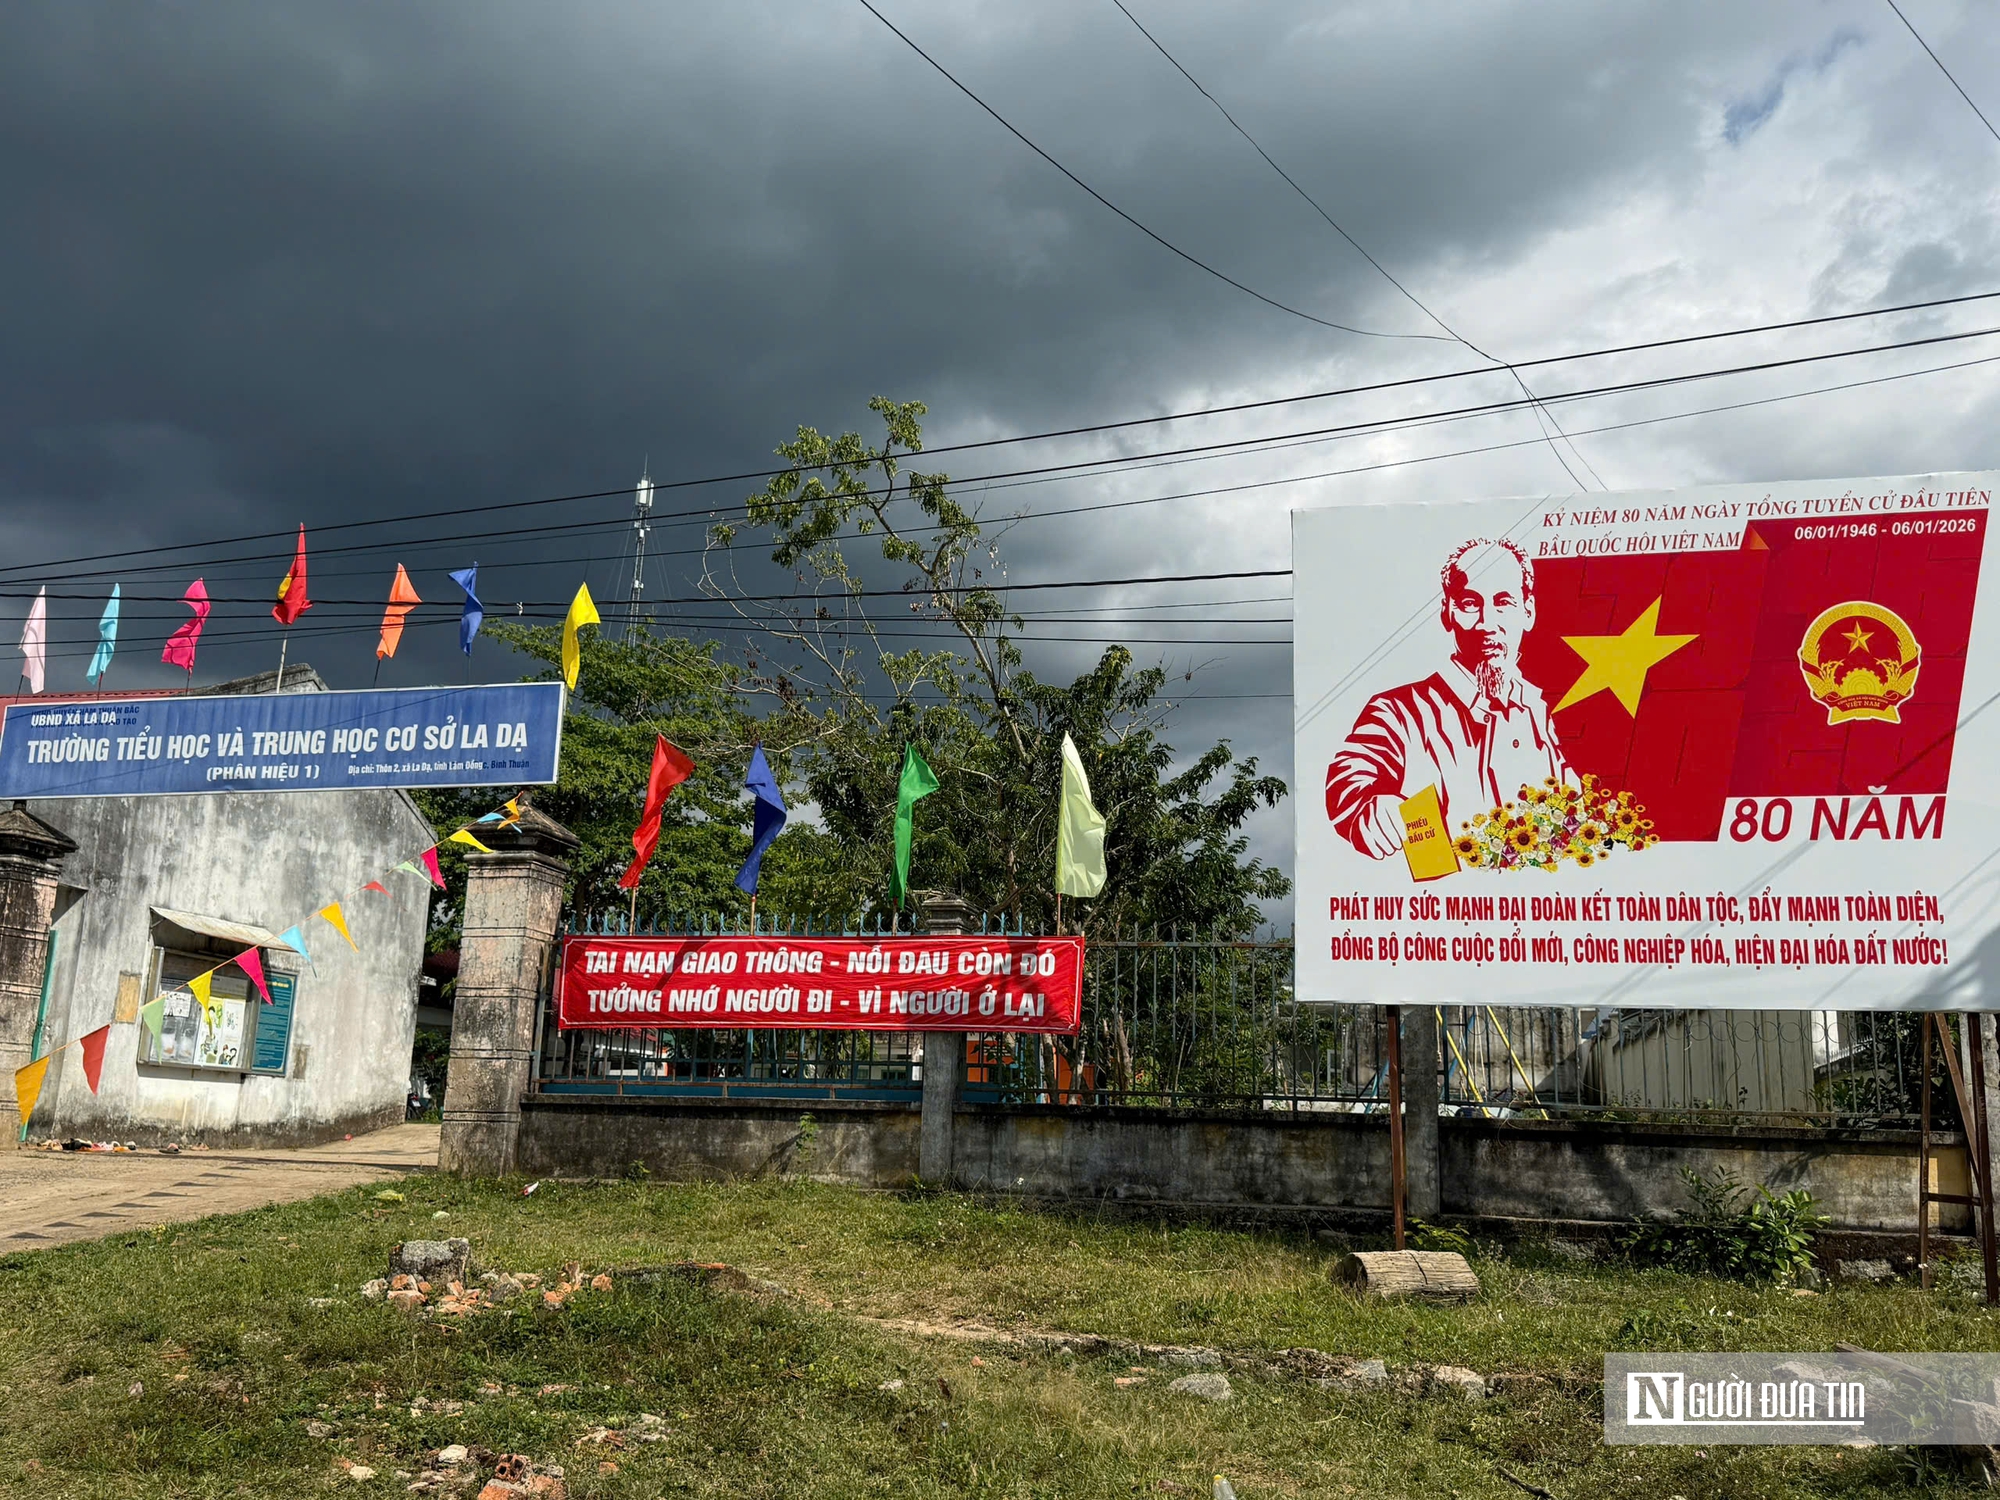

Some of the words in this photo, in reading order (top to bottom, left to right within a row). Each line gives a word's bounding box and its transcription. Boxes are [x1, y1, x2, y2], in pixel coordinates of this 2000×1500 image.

[1543, 507, 1566, 527] KỶ
[1570, 506, 1617, 528] NIỆM
[1621, 509, 1640, 523] 80
[1644, 504, 1692, 522] NĂM
[1691, 500, 1741, 519] NGÀY
[1746, 494, 1797, 516] TỔNG
[1802, 490, 1864, 513] TUYỂN
[1868, 489, 1897, 510] CỬ
[1900, 487, 1940, 509] ĐẦU
[1946, 487, 1992, 506] TIÊN
[1538, 533, 1571, 556] BẦU
[1575, 531, 1622, 557] QUỐC
[1702, 532, 1741, 548] NAM
[1794, 523, 1877, 540] 06/01/1946
[1891, 519, 1976, 536] 06/01/2026
[31, 714, 63, 727] UBND
[84, 713, 97, 724] LA
[101, 711, 117, 726] DẠ
[27, 733, 110, 763] TRƯỜNG
[116, 725, 162, 760] TIỂU
[166, 733, 211, 764] HỌC
[217, 727, 244, 756] VÀ
[252, 730, 326, 756] TRUNG
[332, 728, 378, 758] HỌC
[385, 724, 418, 752] CƠ
[424, 715, 457, 750] SỞ
[460, 724, 488, 749] LA
[495, 723, 528, 752] DẠ
[206, 763, 256, 782] (PHÂN
[261, 763, 299, 782] HIỆU
[303, 764, 320, 780] 1)
[348, 764, 360, 775] Địa
[376, 763, 392, 773] Thôn
[412, 763, 421, 772] La
[1729, 798, 1793, 842] 80
[1809, 785, 1956, 840] NĂM
[1330, 891, 1369, 920] PHÁT
[1374, 897, 1404, 920] HUY
[1409, 890, 1440, 920] SỨC
[1446, 897, 1494, 926] MẠNH
[1499, 897, 1526, 926] ĐẠI
[1531, 891, 1577, 921] ĐOÀN
[1581, 888, 1611, 921] KẾT
[1616, 891, 1660, 921] TOÀN
[1666, 891, 1701, 921] DÂN
[1706, 891, 1744, 927] TỘC,
[1749, 886, 1782, 921] ĐẨY
[1787, 896, 1840, 927] MẠNH
[1844, 890, 1891, 921] TOÀN
[1897, 890, 1944, 927] DIỆN,
[585, 951, 618, 973] TAI
[623, 952, 675, 978] NẠN
[681, 952, 738, 974] GIAO
[745, 946, 823, 973] THÔNG
[847, 944, 891, 973] NỖI
[898, 951, 949, 974] ĐAU
[957, 946, 1012, 976] CÒN
[1020, 948, 1056, 976] ĐÓ
[1331, 928, 1373, 960] ĐỒNG
[1378, 932, 1399, 966] BỘ
[1404, 932, 1447, 961] CÔNG
[1451, 932, 1495, 967] CUỘC
[1499, 928, 1526, 962] ĐỔI
[1531, 931, 1568, 966] MỚI,
[1573, 933, 1619, 963] CÔNG
[1624, 933, 1685, 969] NGHIỆP
[1690, 933, 1731, 967] HÓA,
[1735, 934, 1774, 970] HIỆN
[1780, 938, 1809, 970] ĐẠI
[1814, 933, 1850, 964] HÓA
[1854, 930, 1887, 964] ĐẤT
[1893, 931, 1948, 965] NƯỚC!
[588, 982, 662, 1013] TƯỞNG
[668, 984, 720, 1013] NHỚ
[725, 983, 800, 1013] NGƯỜI
[806, 989, 832, 1013] ĐI
[858, 985, 882, 1013] VÌ
[889, 986, 970, 1015] NGƯỜI
[978, 984, 997, 1015] Ở
[1004, 992, 1045, 1021] LẠI
